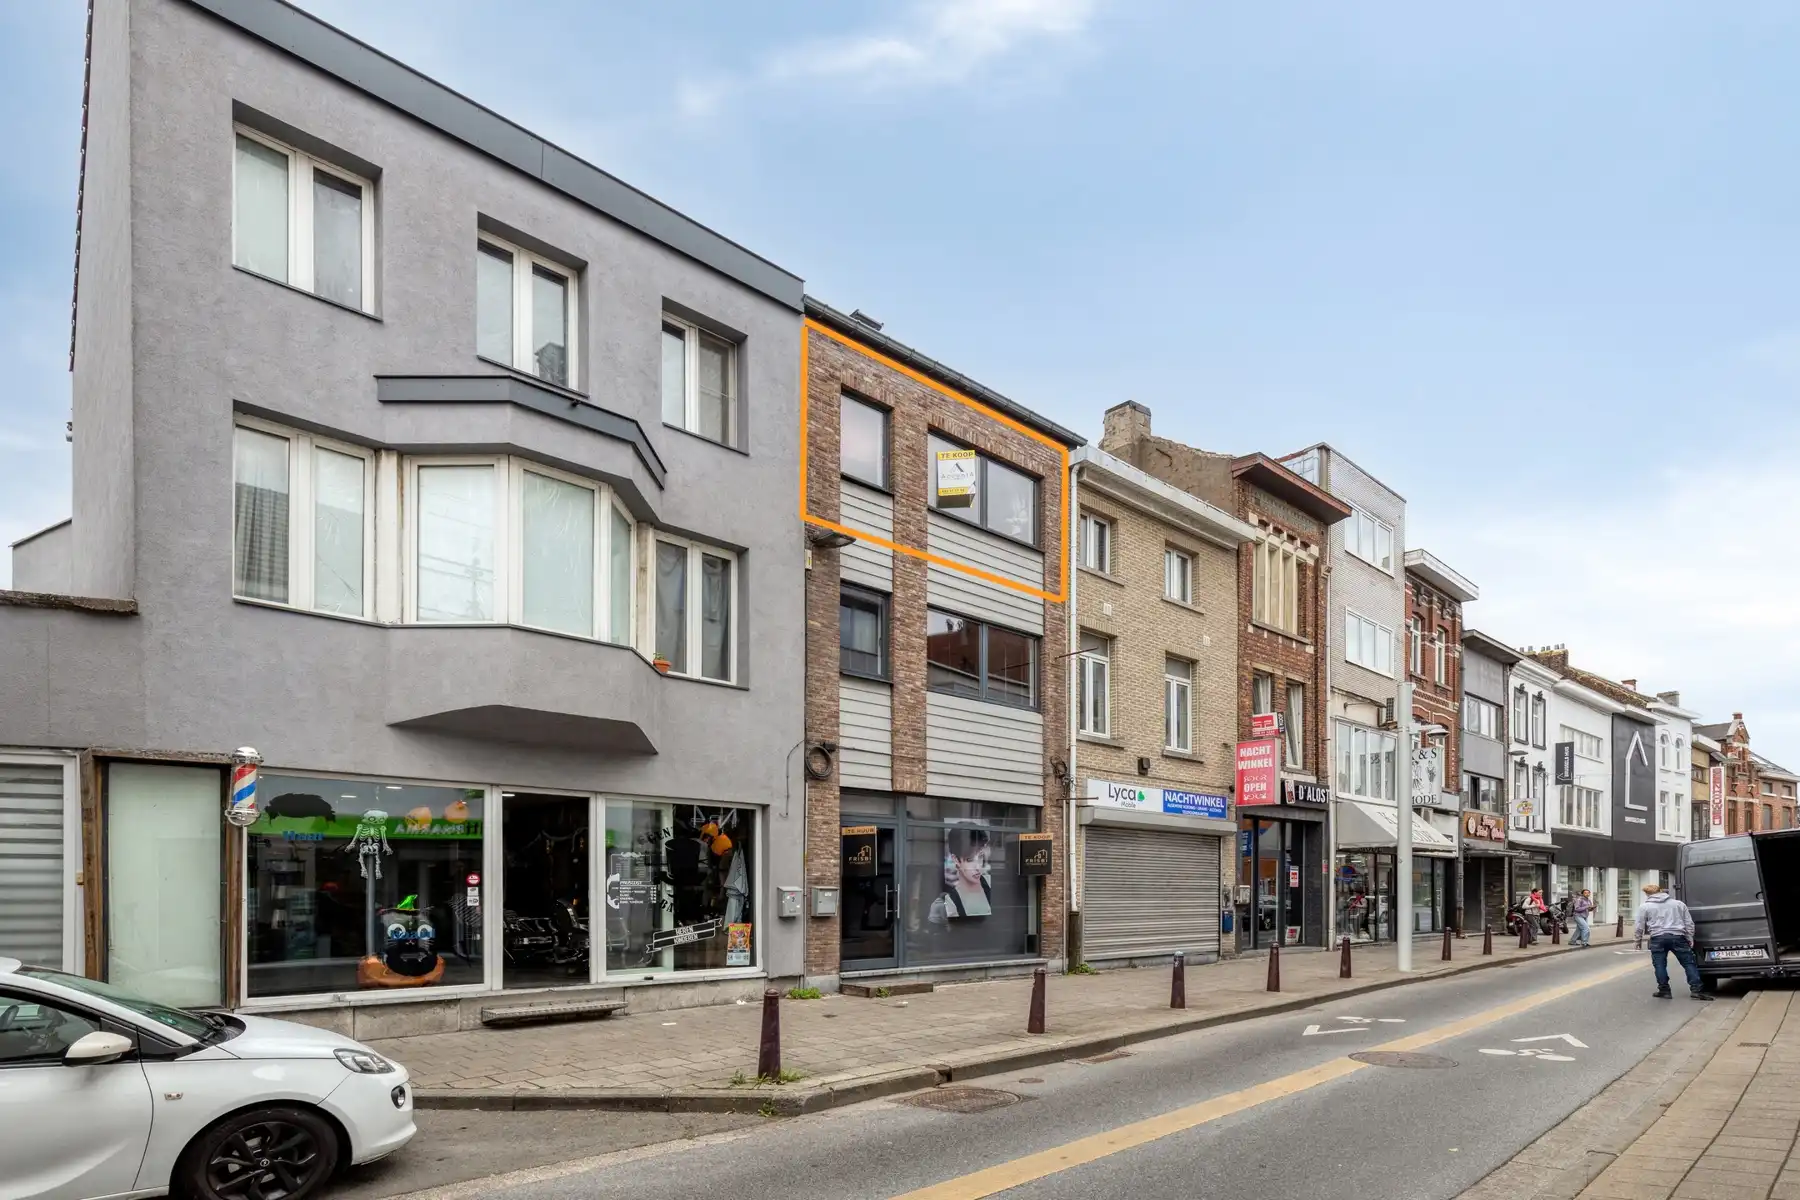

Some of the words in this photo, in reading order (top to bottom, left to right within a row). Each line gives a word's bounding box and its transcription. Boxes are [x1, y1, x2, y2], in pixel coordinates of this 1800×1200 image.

[1240, 745, 1272, 757] NACHT
[1430, 748, 1437, 758] S
[1238, 758, 1273, 770] WINKEL
[1108, 784, 1136, 801] Lyca
[1243, 782, 1267, 792] OPEN
[1164, 791, 1225, 808] NACHTWINKEL
[1298, 785, 1331, 804] D'ALOST
[675, 925, 694, 936] HEREN
[673, 933, 699, 945] KINDEREN
